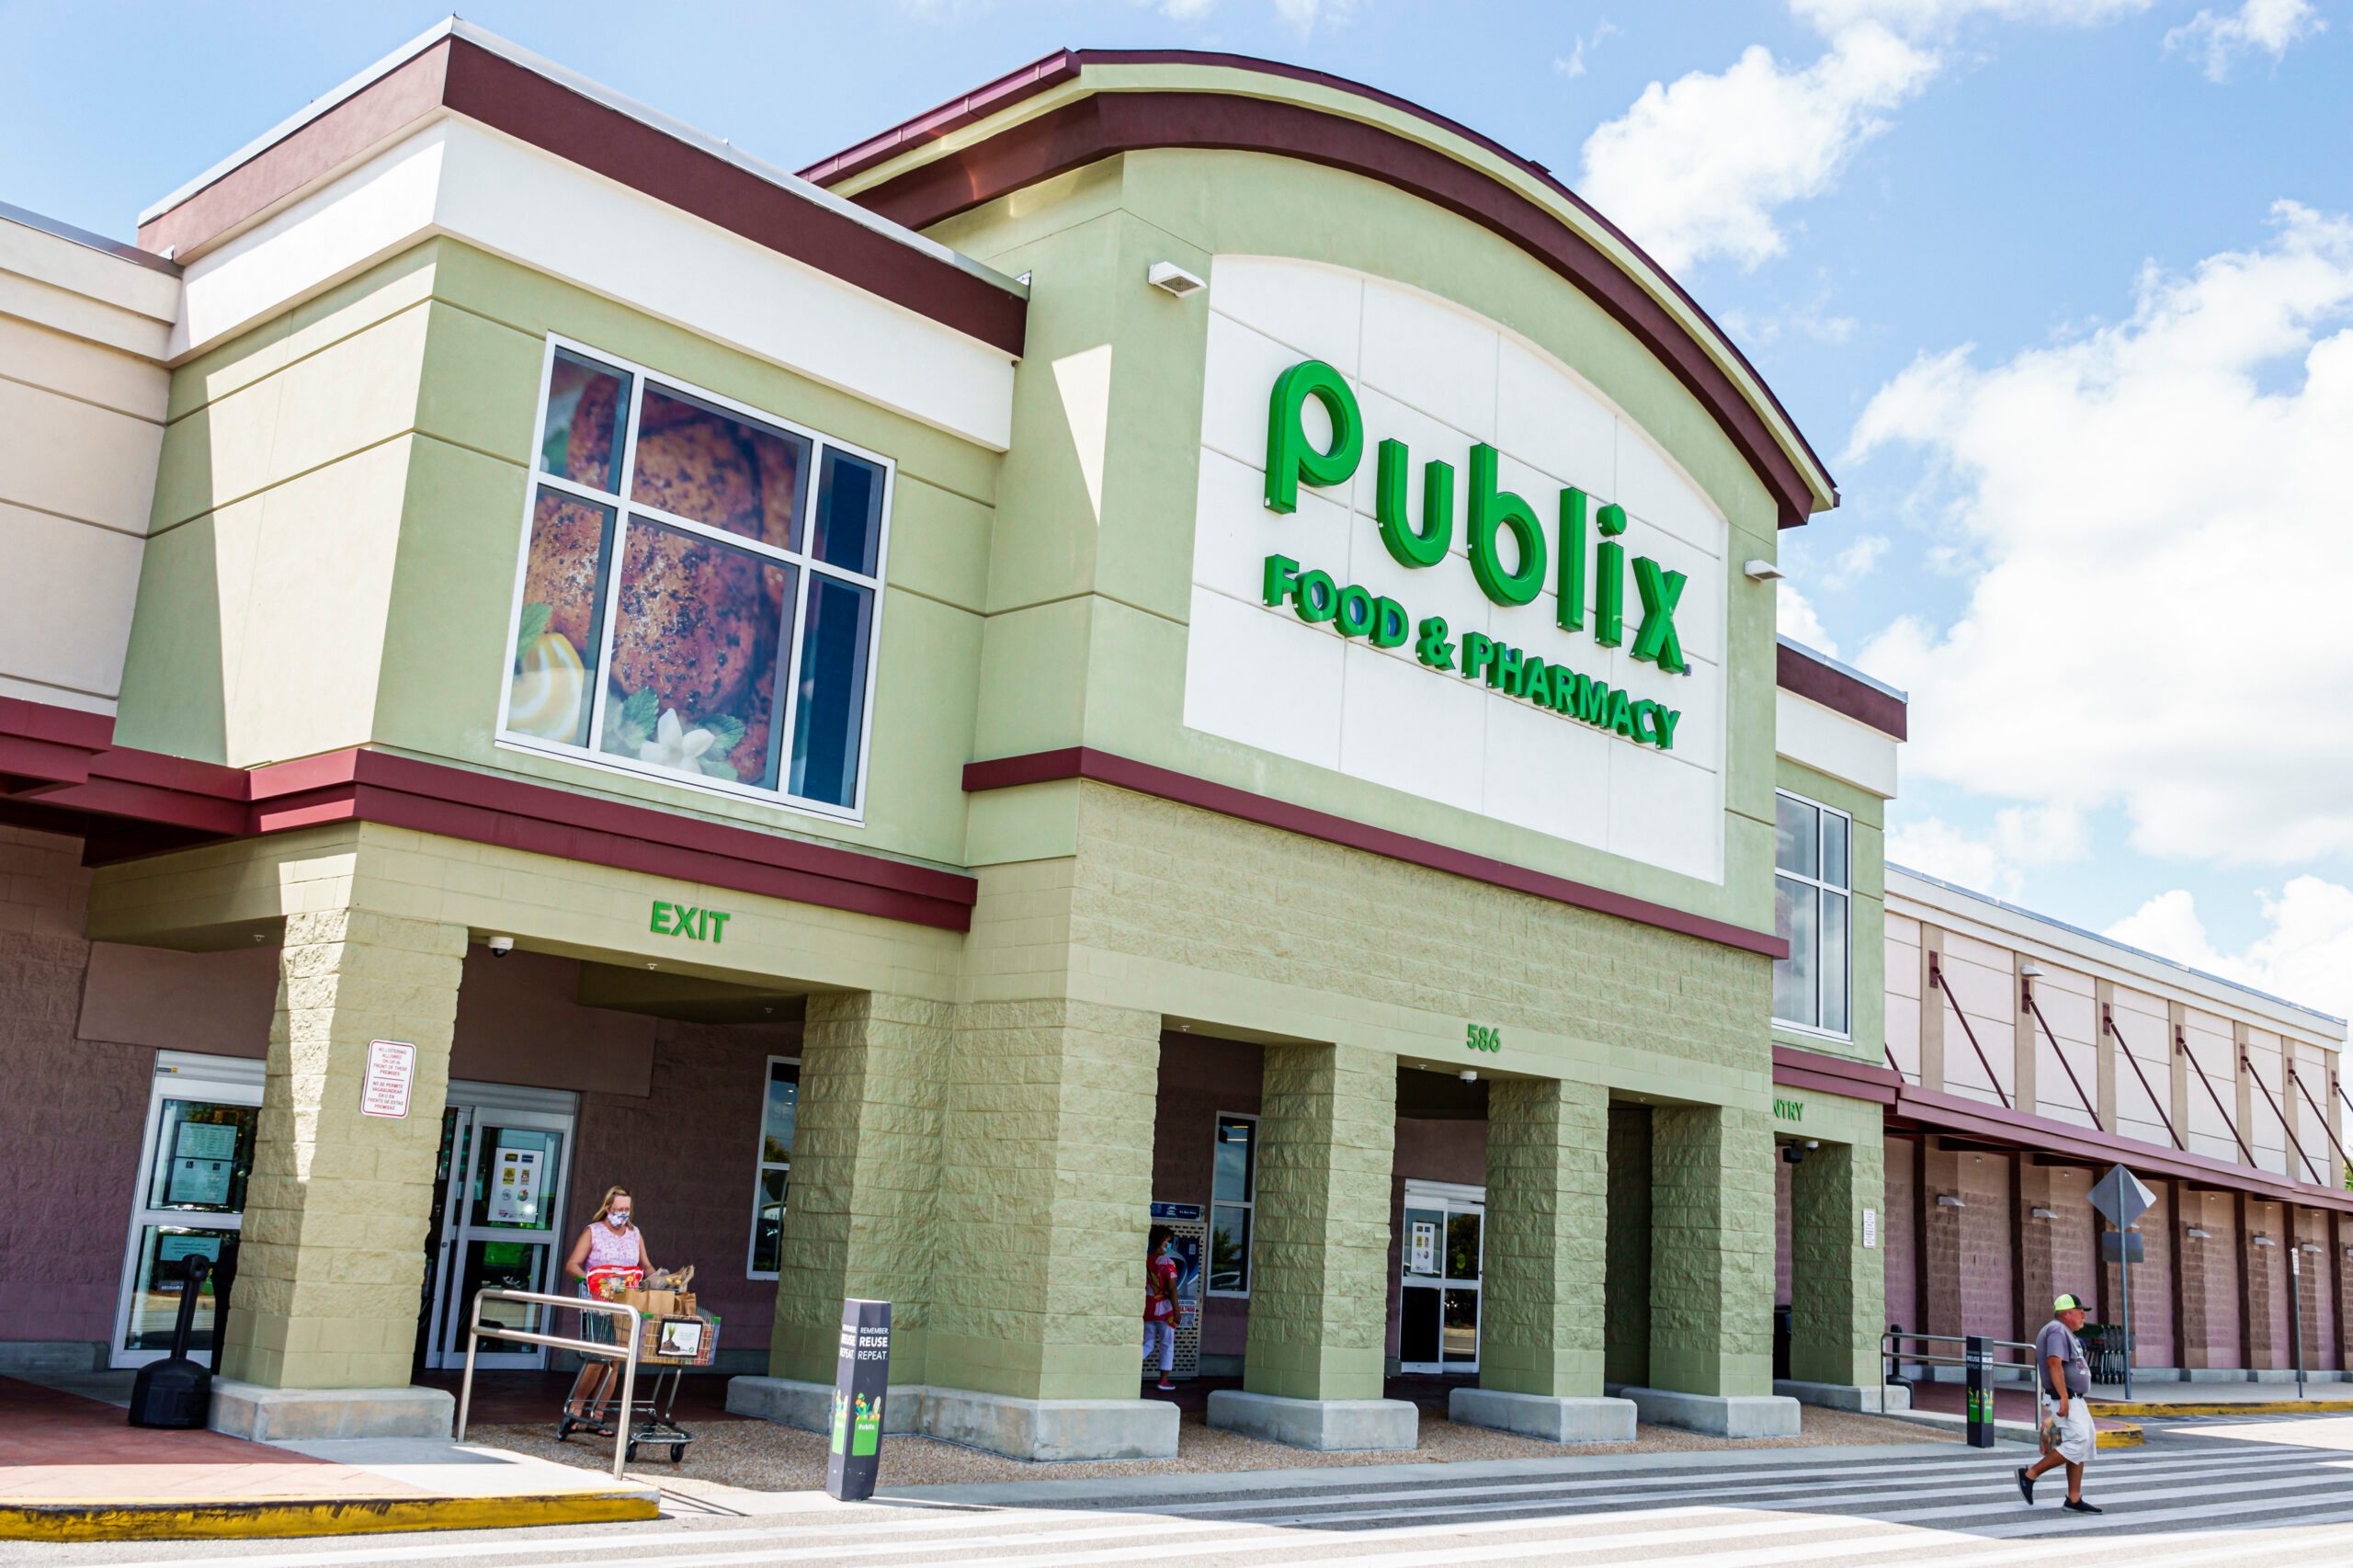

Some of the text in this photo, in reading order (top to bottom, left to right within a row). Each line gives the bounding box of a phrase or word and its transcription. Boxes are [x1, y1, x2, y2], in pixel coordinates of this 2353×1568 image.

[1264, 359, 1688, 674] Publix
[1263, 553, 1681, 749] FOOD & PHARMACY
[651, 901, 731, 943] EXIT
[1466, 1023, 1501, 1052] 586
